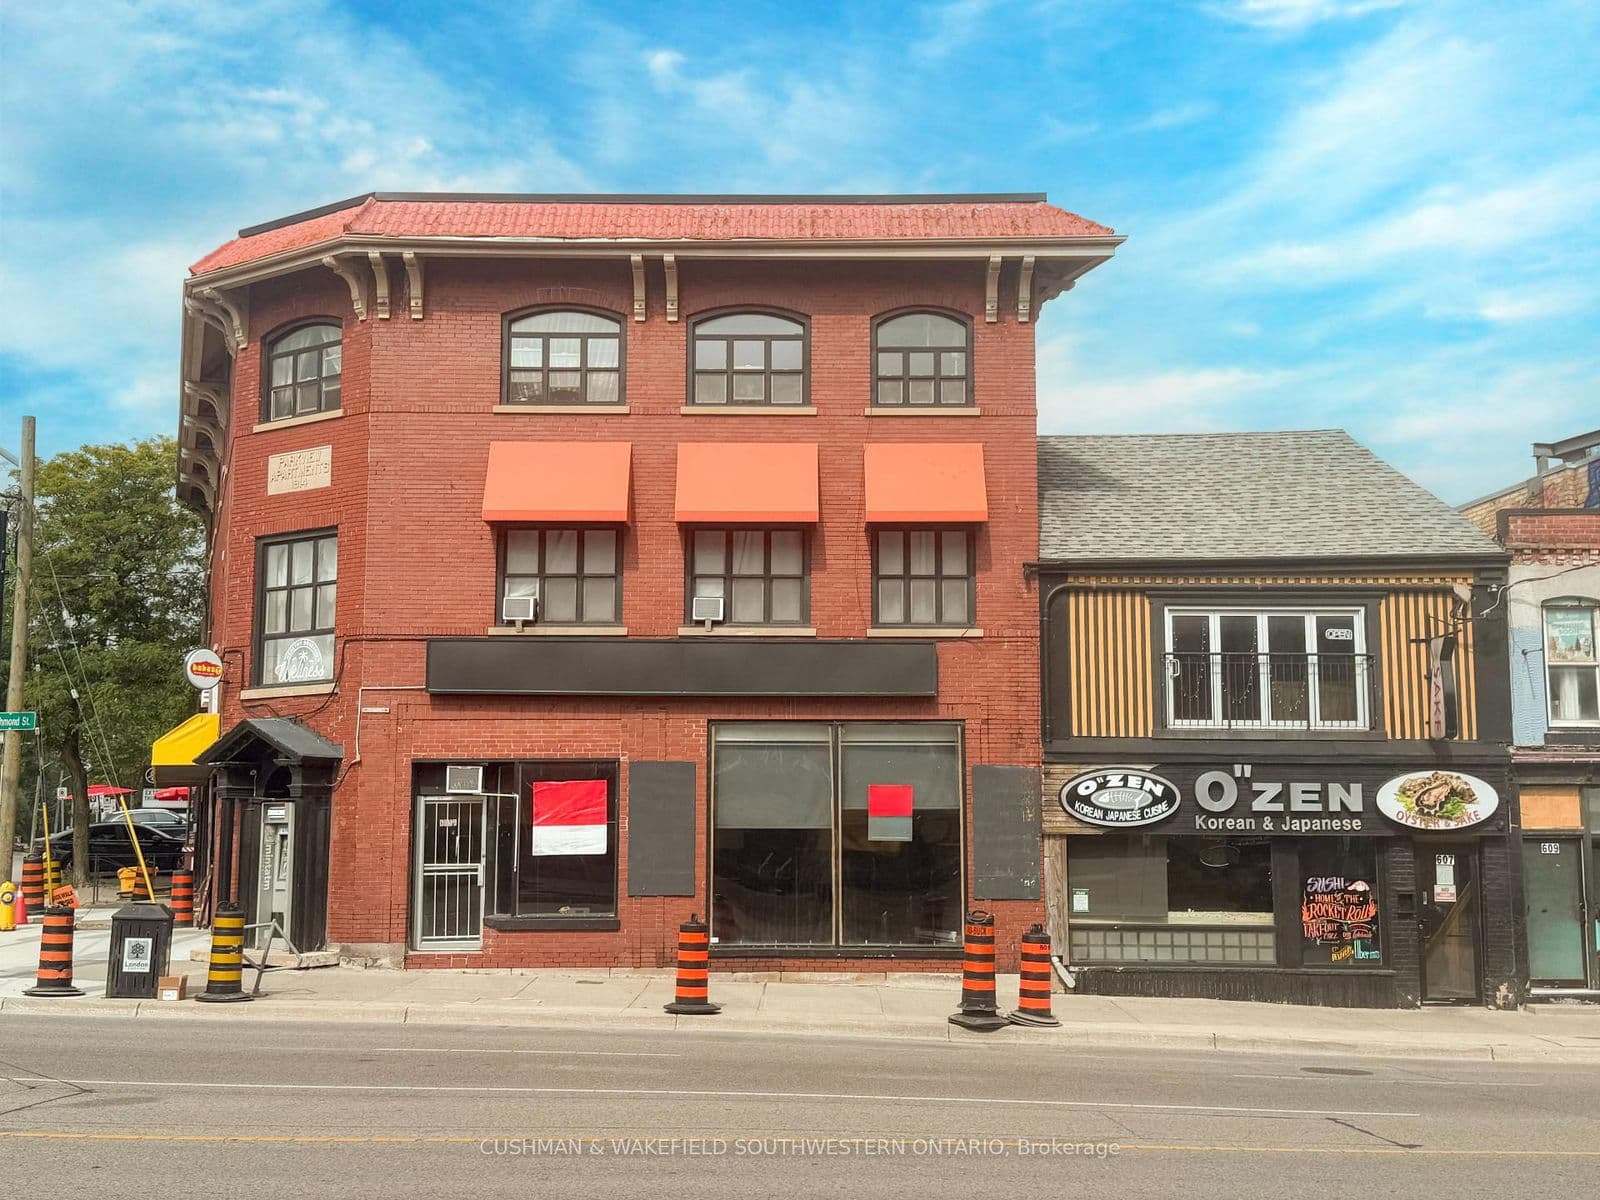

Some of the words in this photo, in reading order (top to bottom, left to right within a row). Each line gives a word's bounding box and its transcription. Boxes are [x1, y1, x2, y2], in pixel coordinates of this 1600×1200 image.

[1074, 800, 1104, 819] KOREAN
[1105, 808, 1142, 821] JAPANESE
[1143, 800, 1169, 818] CUISINE
[1195, 815, 1256, 830] Korean
[1263, 816, 1274, 831] &
[1281, 816, 1362, 832] Japanese
[1396, 810, 1440, 828] OYSTER
[1454, 810, 1481, 826] SAKE
[1542, 844, 1559, 853] 609
[1437, 855, 1453, 864] 607
[1306, 877, 1345, 892] SUSHI
[1314, 894, 1334, 903] HOME
[1344, 895, 1359, 904] THE
[1307, 903, 1346, 920] ROCKET
